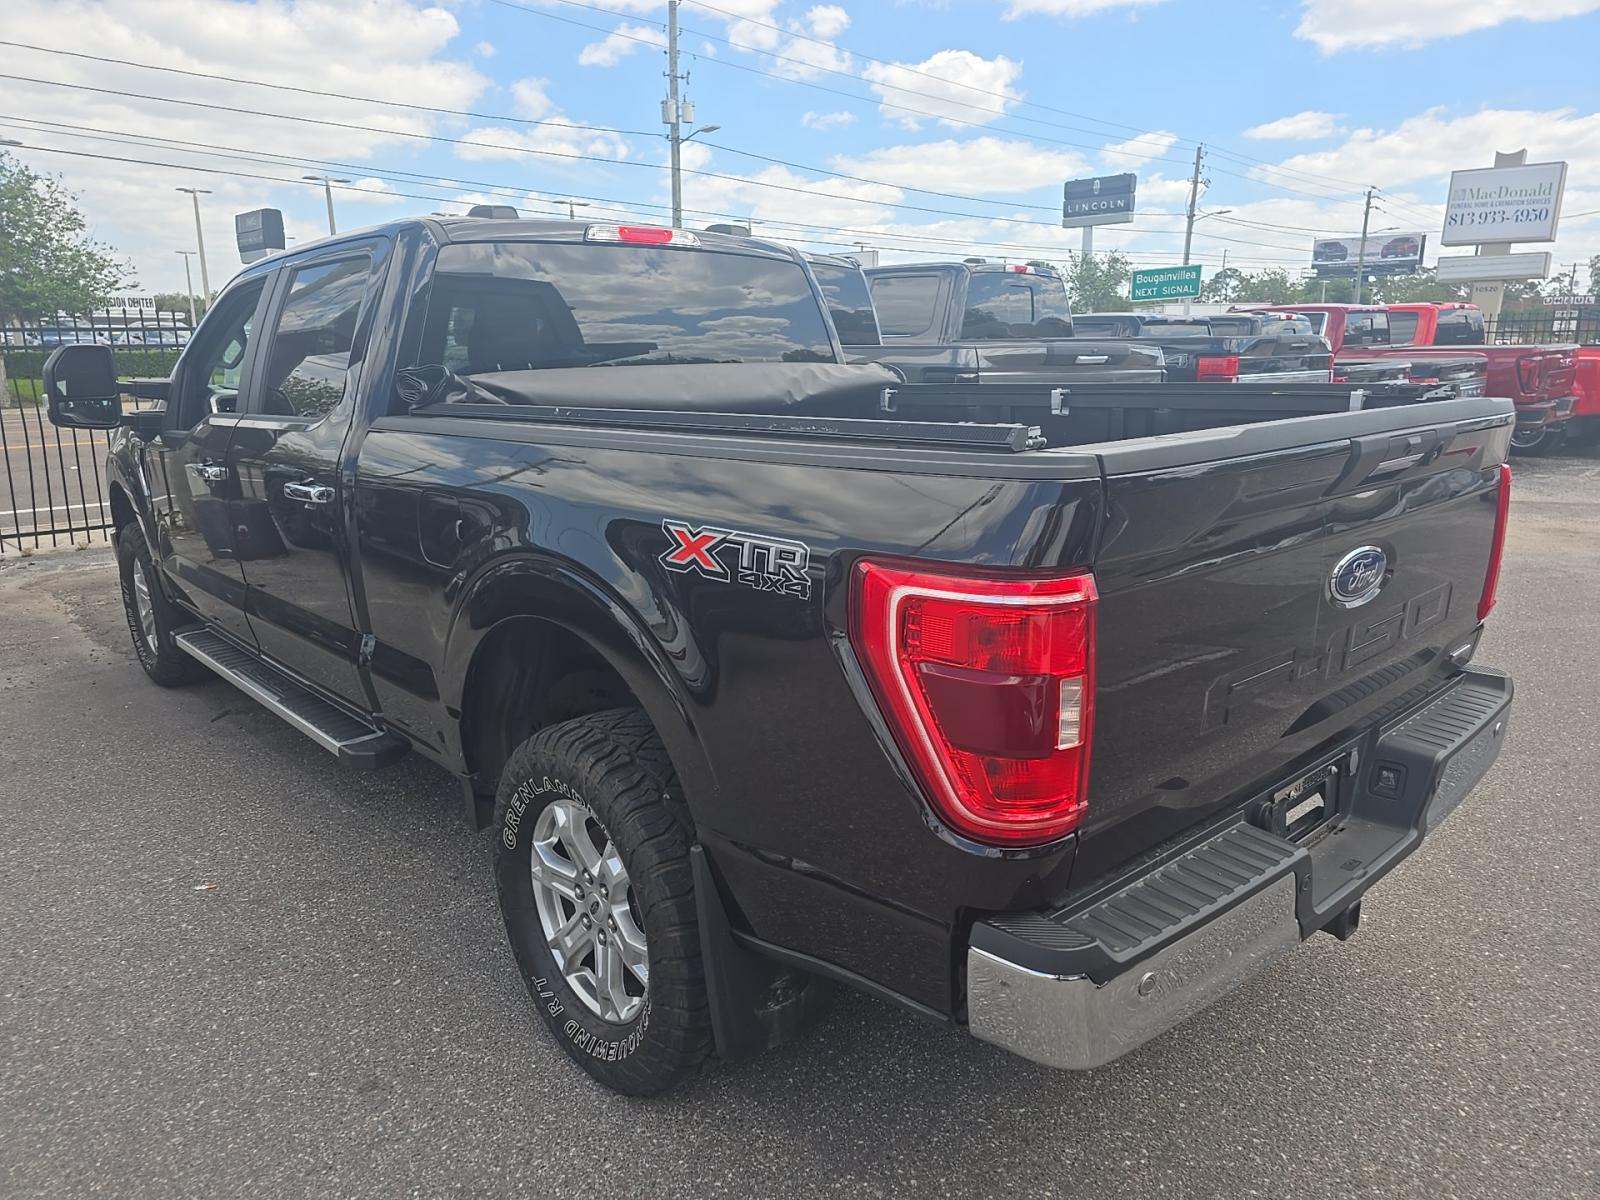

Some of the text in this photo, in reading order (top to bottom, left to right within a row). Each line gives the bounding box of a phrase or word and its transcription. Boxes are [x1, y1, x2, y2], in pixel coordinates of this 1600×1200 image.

[1465, 182, 1553, 201] MacDonald
[1067, 199, 1125, 213] LINCOLN
[1448, 207, 1549, 227] 813 933-4950
[1136, 270, 1197, 285] Bougainvillea
[1135, 285, 1195, 297] NEXT SIGNAL
[128, 297, 155, 309] CENTER
[658, 518, 811, 583] XTR
[1348, 558, 1380, 591] Ford
